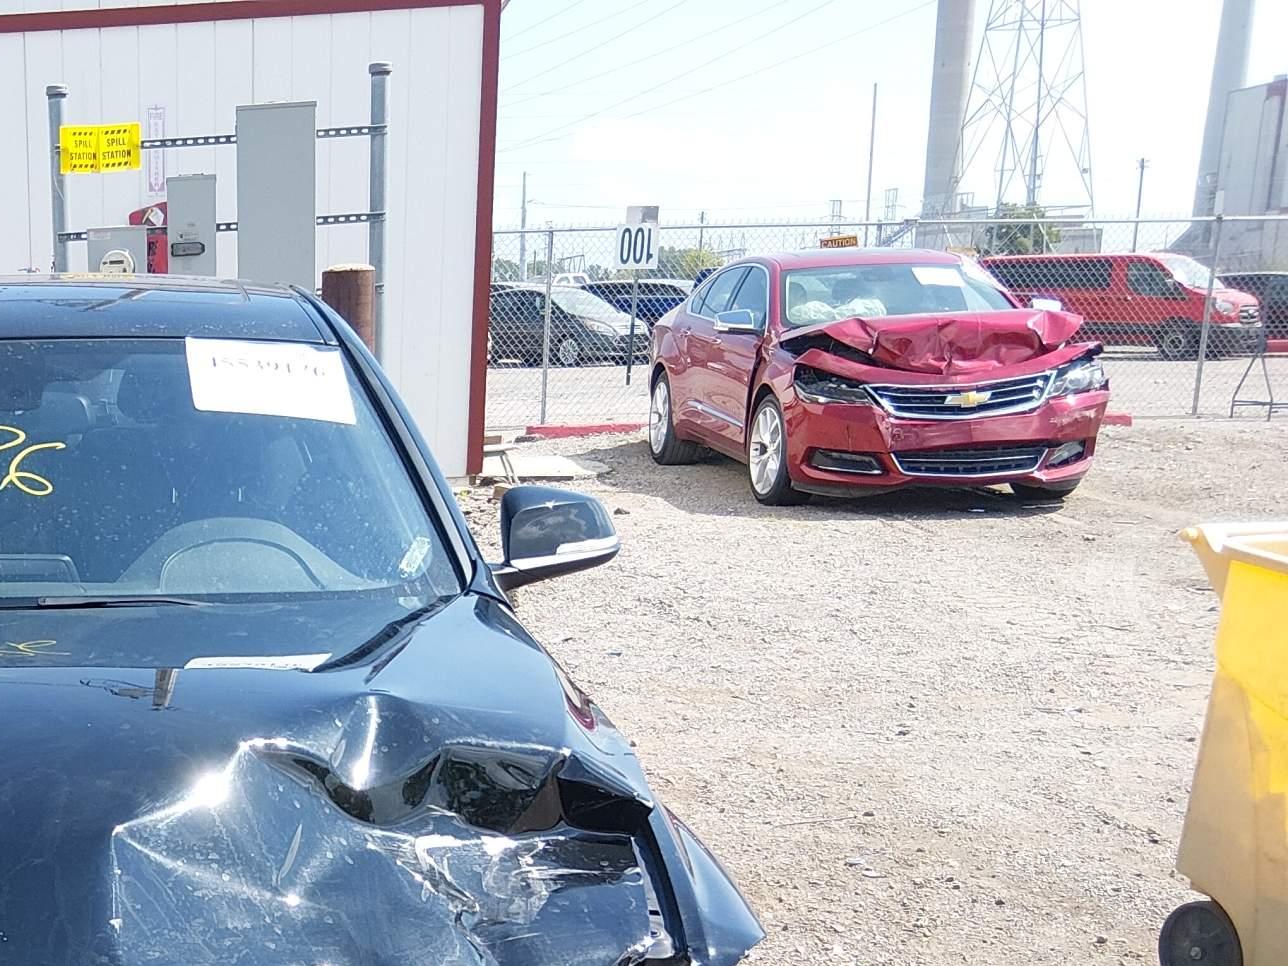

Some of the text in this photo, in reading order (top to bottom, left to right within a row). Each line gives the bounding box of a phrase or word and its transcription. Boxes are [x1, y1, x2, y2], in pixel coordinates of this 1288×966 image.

[74, 140, 92, 148] SPILL
[106, 138, 126, 147] SPILL
[69, 152, 97, 160] STATION
[102, 149, 131, 160] STATION
[620, 227, 653, 264] 100
[821, 237, 857, 248] CAUTION
